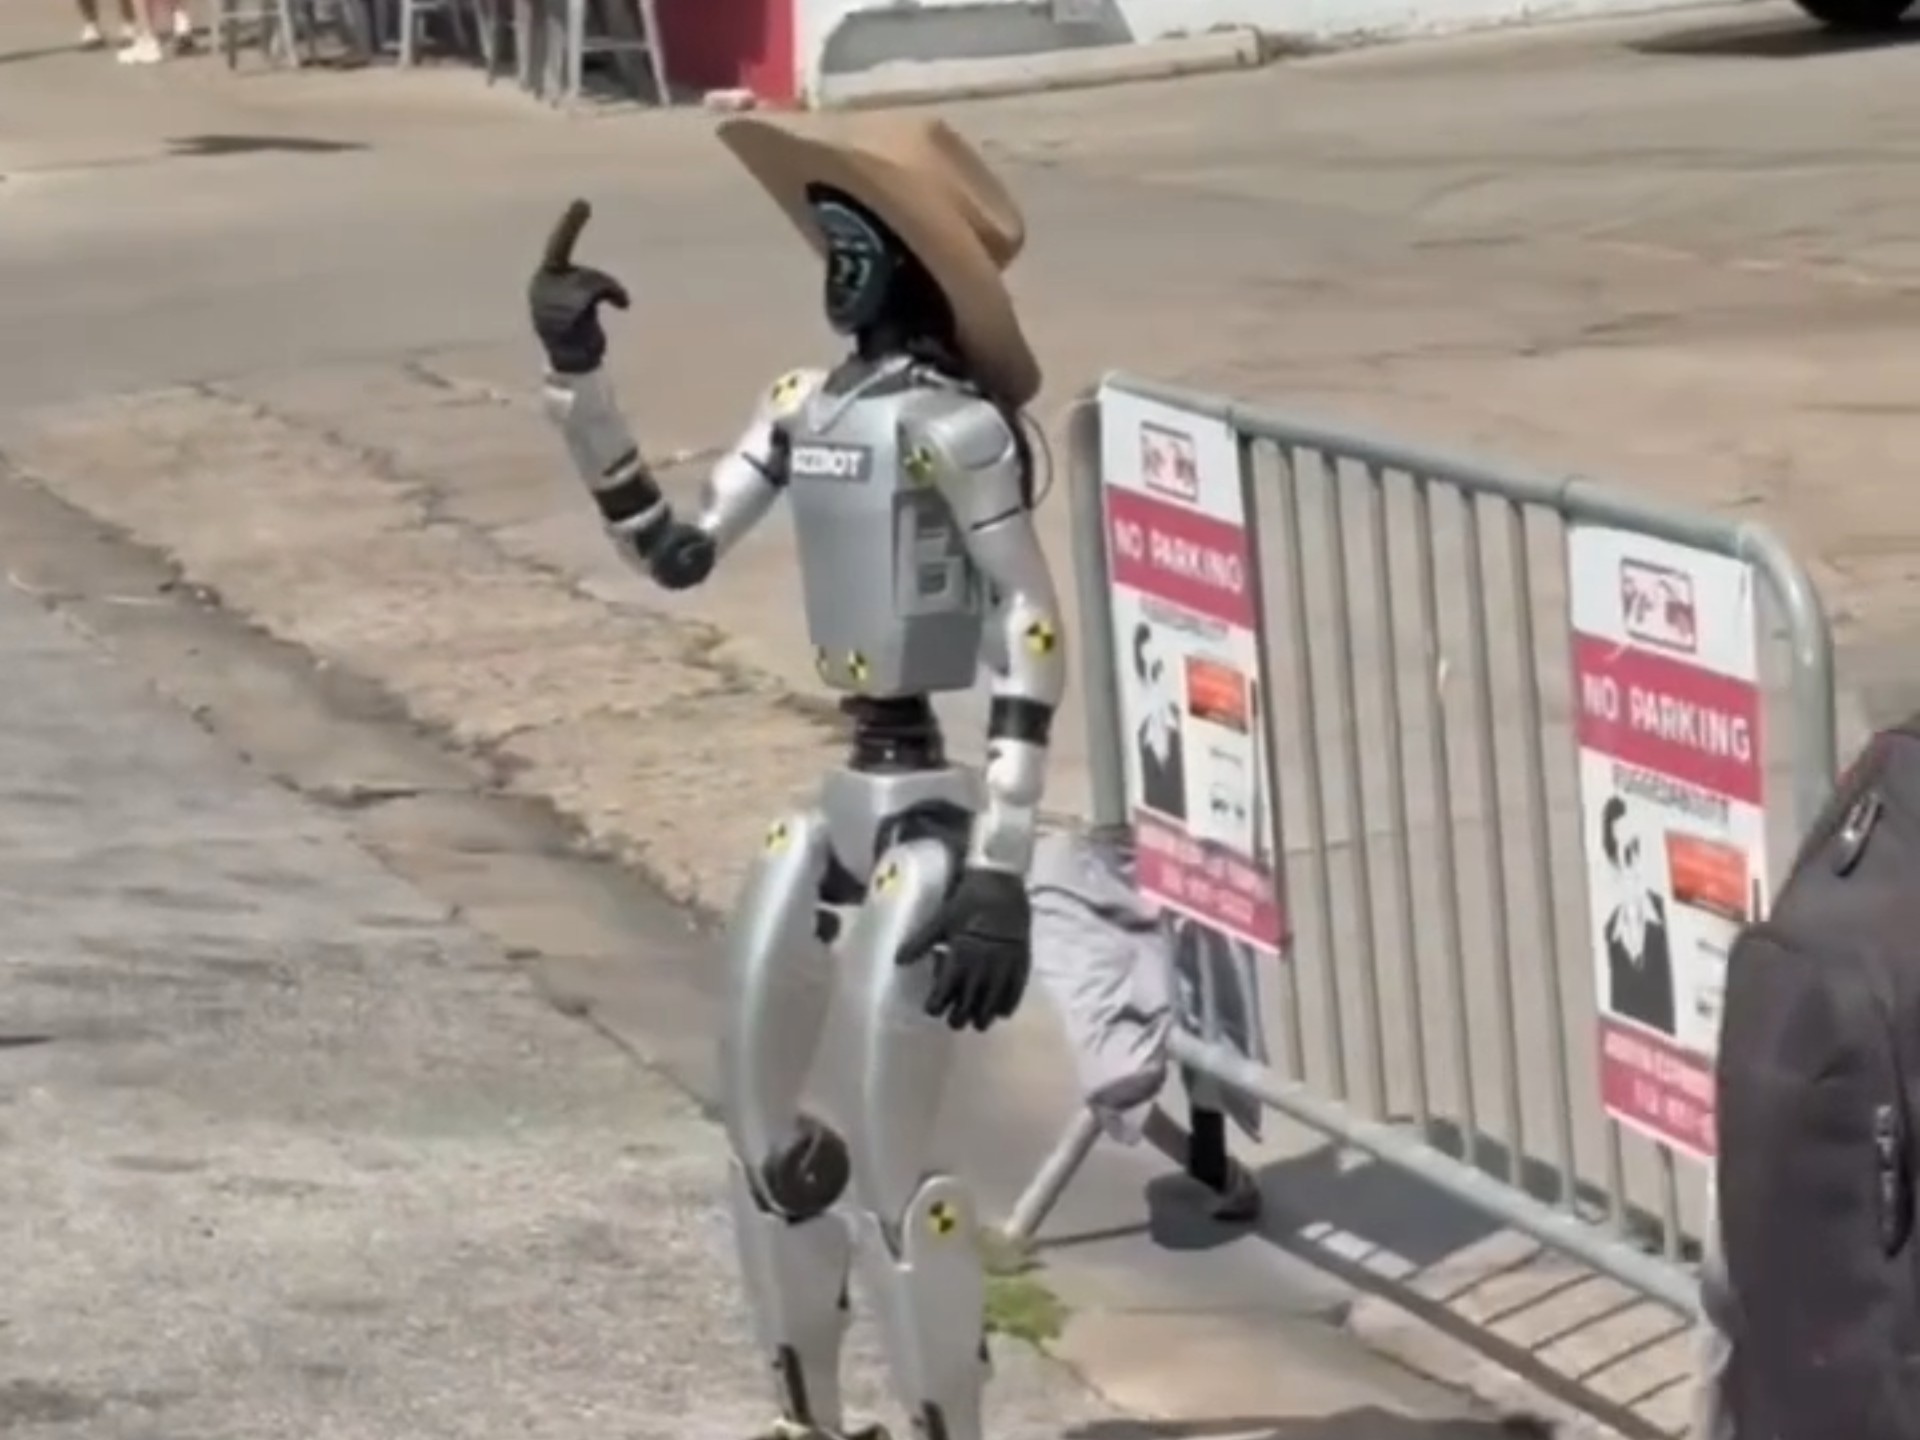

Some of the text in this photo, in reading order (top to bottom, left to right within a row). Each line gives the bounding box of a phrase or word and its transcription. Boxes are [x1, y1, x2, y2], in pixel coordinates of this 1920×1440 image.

[1114, 517, 1243, 595] NO PARKING
[1582, 672, 1750, 764] NO PARKING
